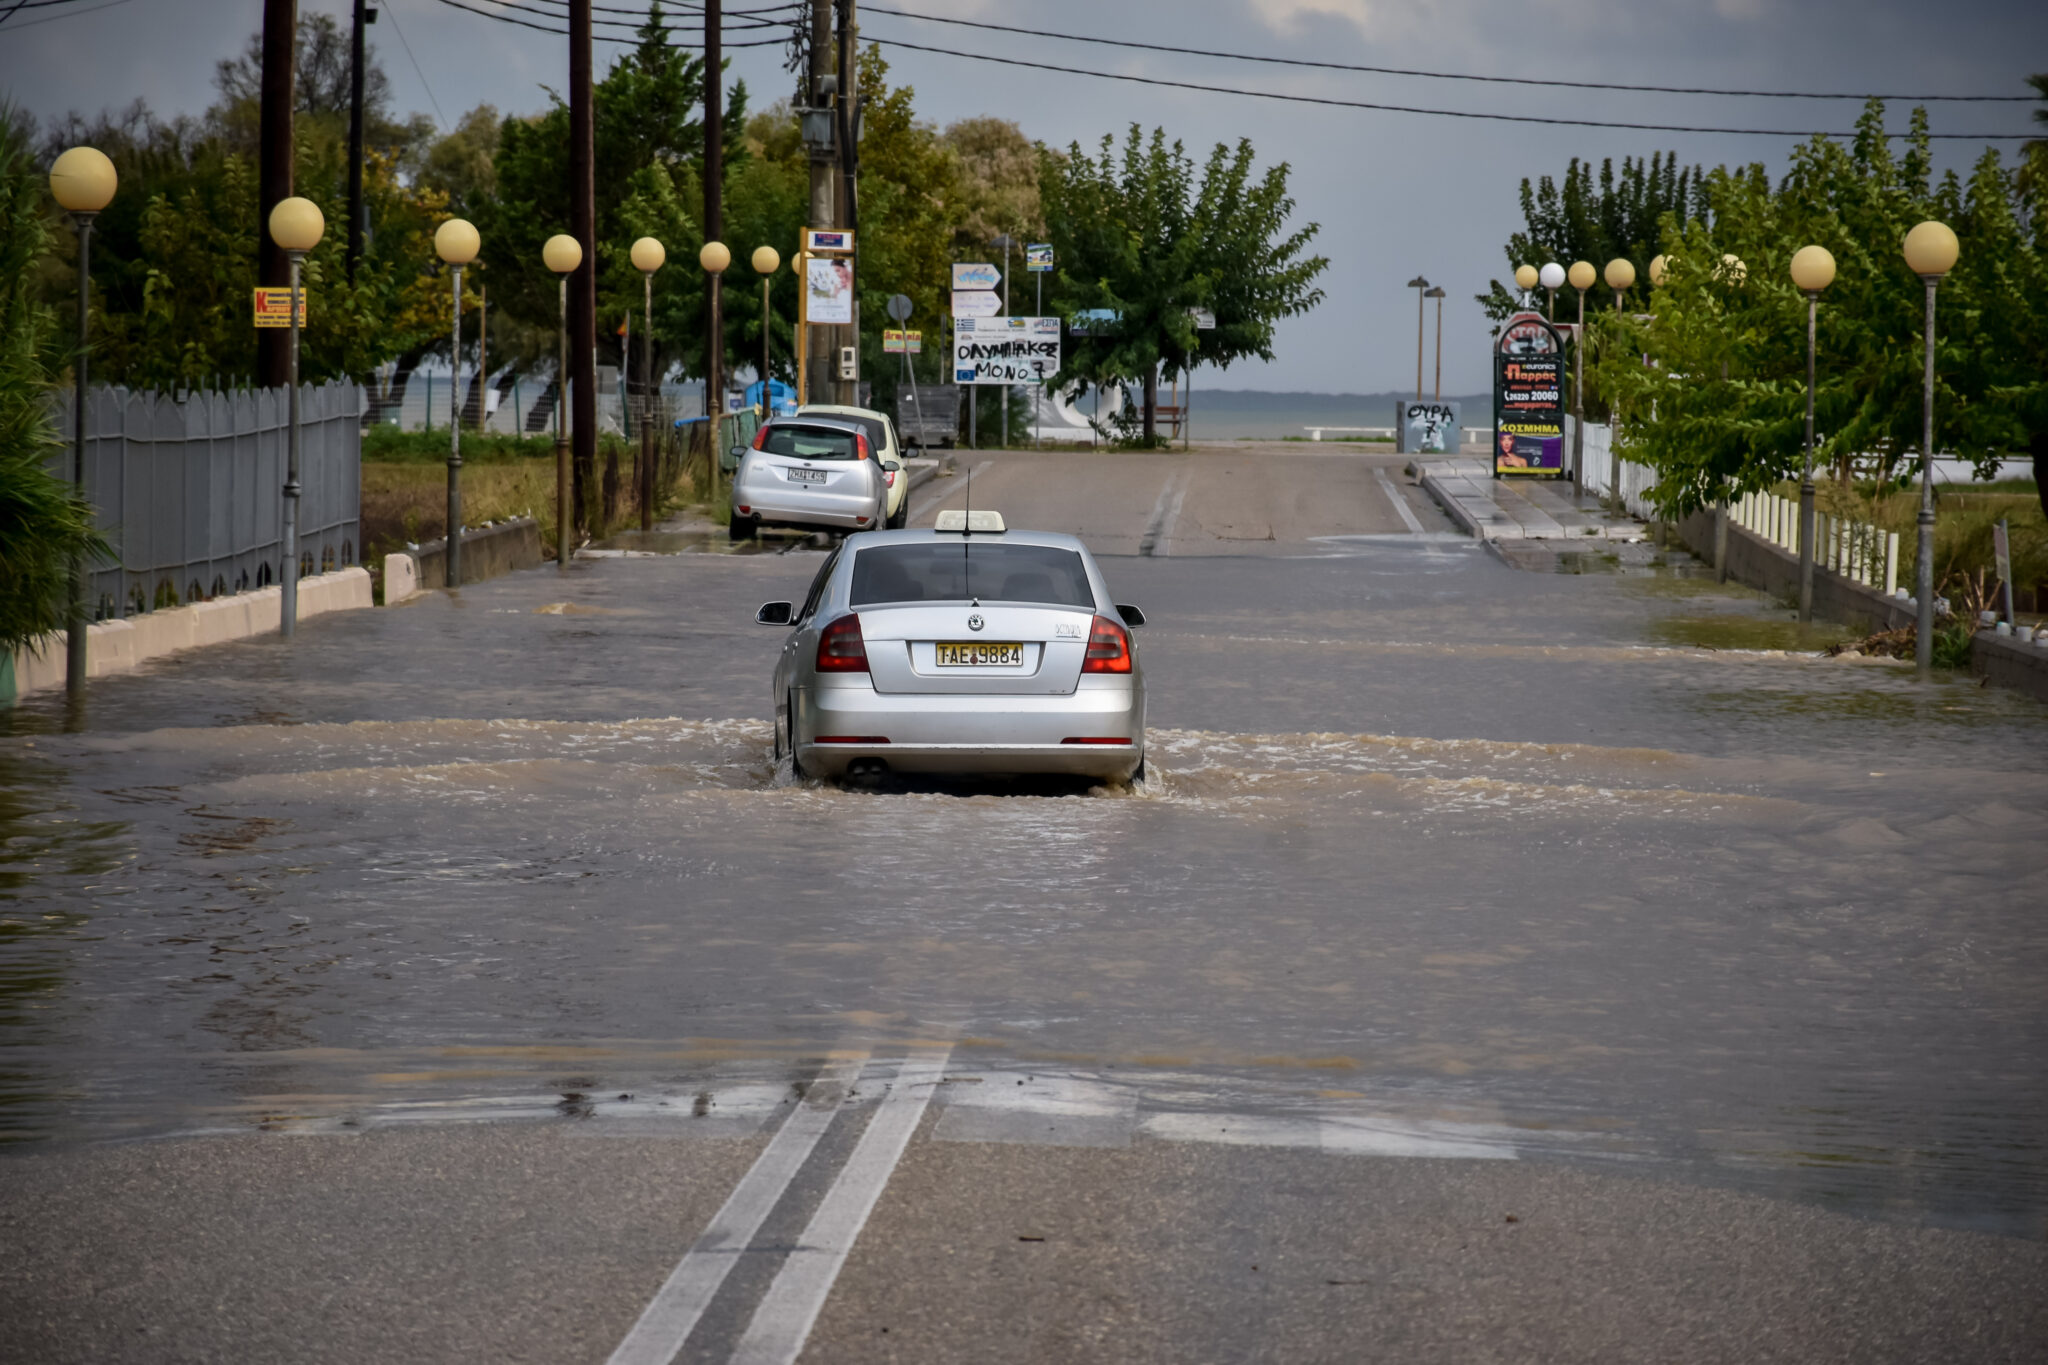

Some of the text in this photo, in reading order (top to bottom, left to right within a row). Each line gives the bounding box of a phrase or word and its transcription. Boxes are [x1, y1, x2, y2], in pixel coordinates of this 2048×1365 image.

[1032, 361, 1046, 380] 7
[1509, 391, 1559, 401] 26220 20060
[1499, 424, 1560, 433] ΚΟΣΜΗΜΑ
